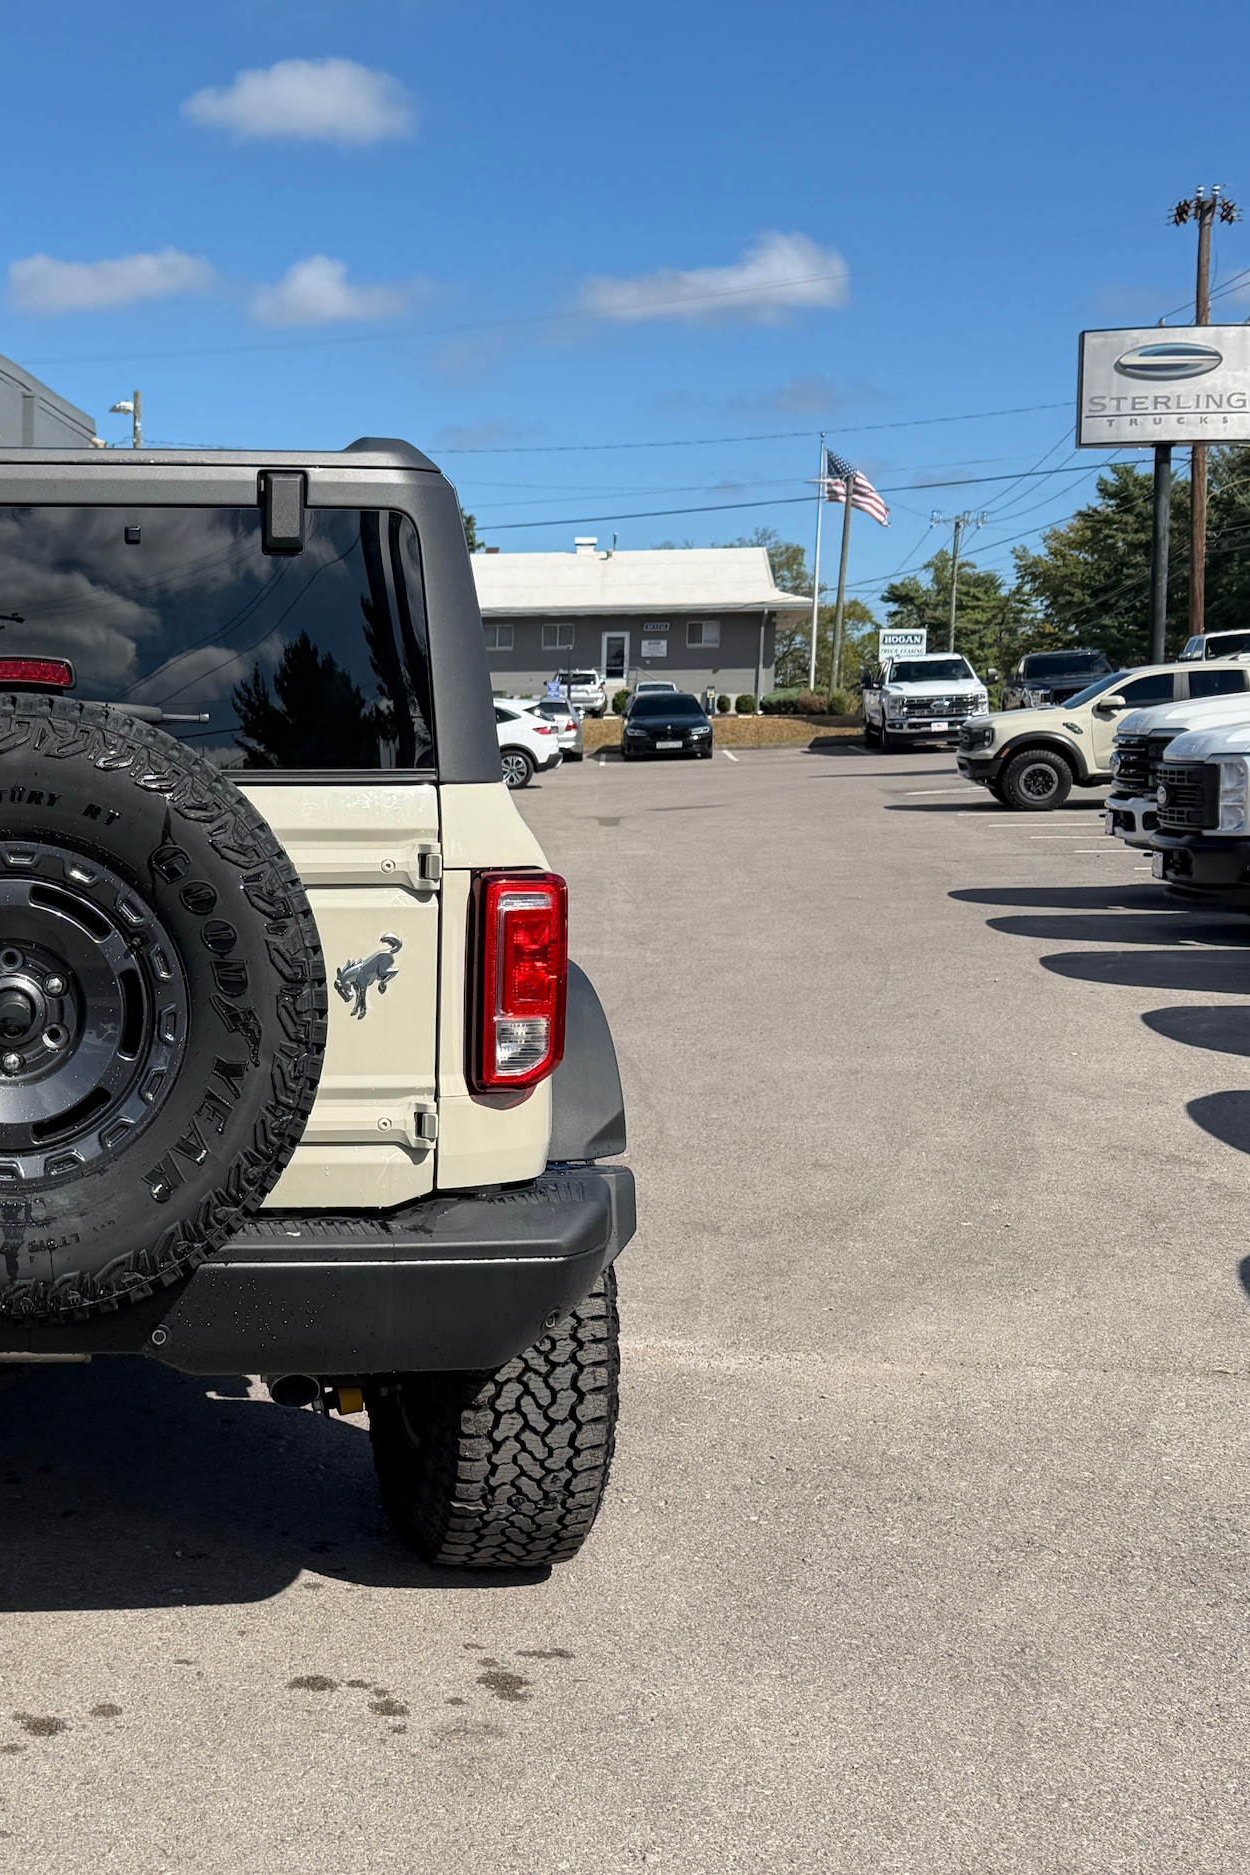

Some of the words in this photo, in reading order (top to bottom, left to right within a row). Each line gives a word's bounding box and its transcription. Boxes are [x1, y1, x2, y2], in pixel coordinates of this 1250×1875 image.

[1088, 392, 1247, 413] STERLING
[1106, 416, 1229, 427] TRUCKS
[82, 802, 123, 826] RT
